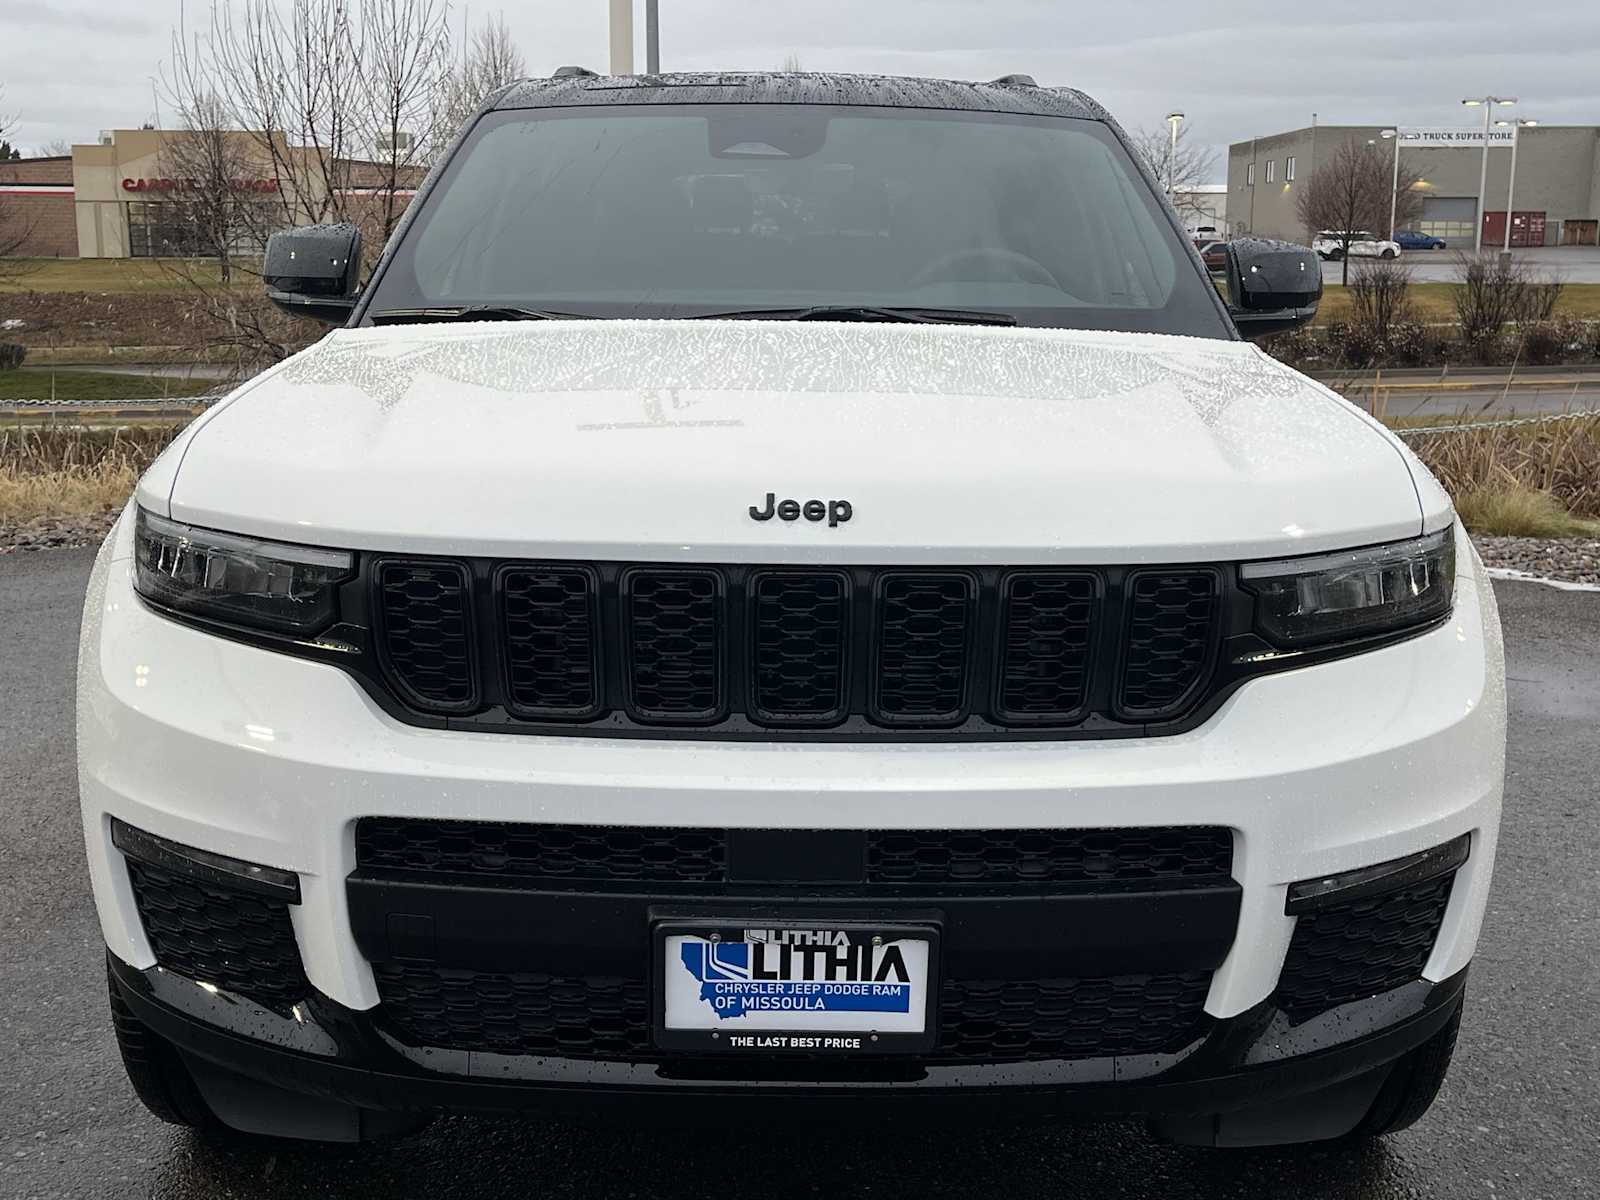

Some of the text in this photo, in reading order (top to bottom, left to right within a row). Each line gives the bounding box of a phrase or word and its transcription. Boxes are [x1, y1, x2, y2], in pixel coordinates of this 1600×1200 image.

[1423, 132, 1453, 140] TRUCK
[749, 492, 853, 528] Jeep
[768, 929, 851, 947] LITHIA
[752, 943, 911, 983] LITHIA
[715, 983, 901, 996] CHRYSLER JEEP DODGE RAM
[715, 997, 825, 1010] OF MISSOULA
[730, 1036, 861, 1049] THE LAST BEST PRICE
